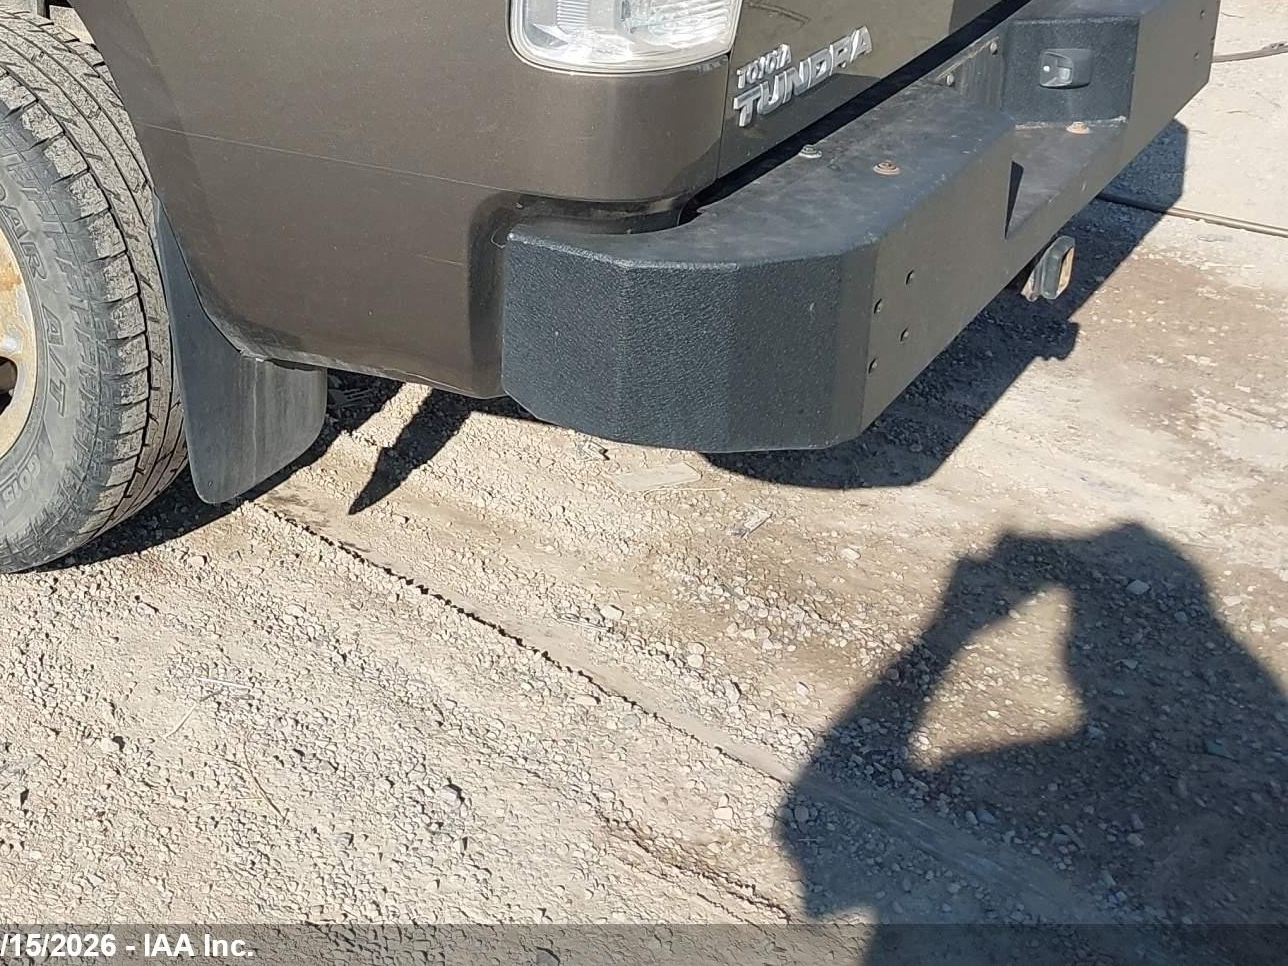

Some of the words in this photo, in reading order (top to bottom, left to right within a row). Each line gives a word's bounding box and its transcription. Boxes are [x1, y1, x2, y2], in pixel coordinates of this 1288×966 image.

[733, 25, 873, 128] TUNDRA
[736, 43, 792, 90] TOYOTA
[41, 303, 67, 418] A/T
